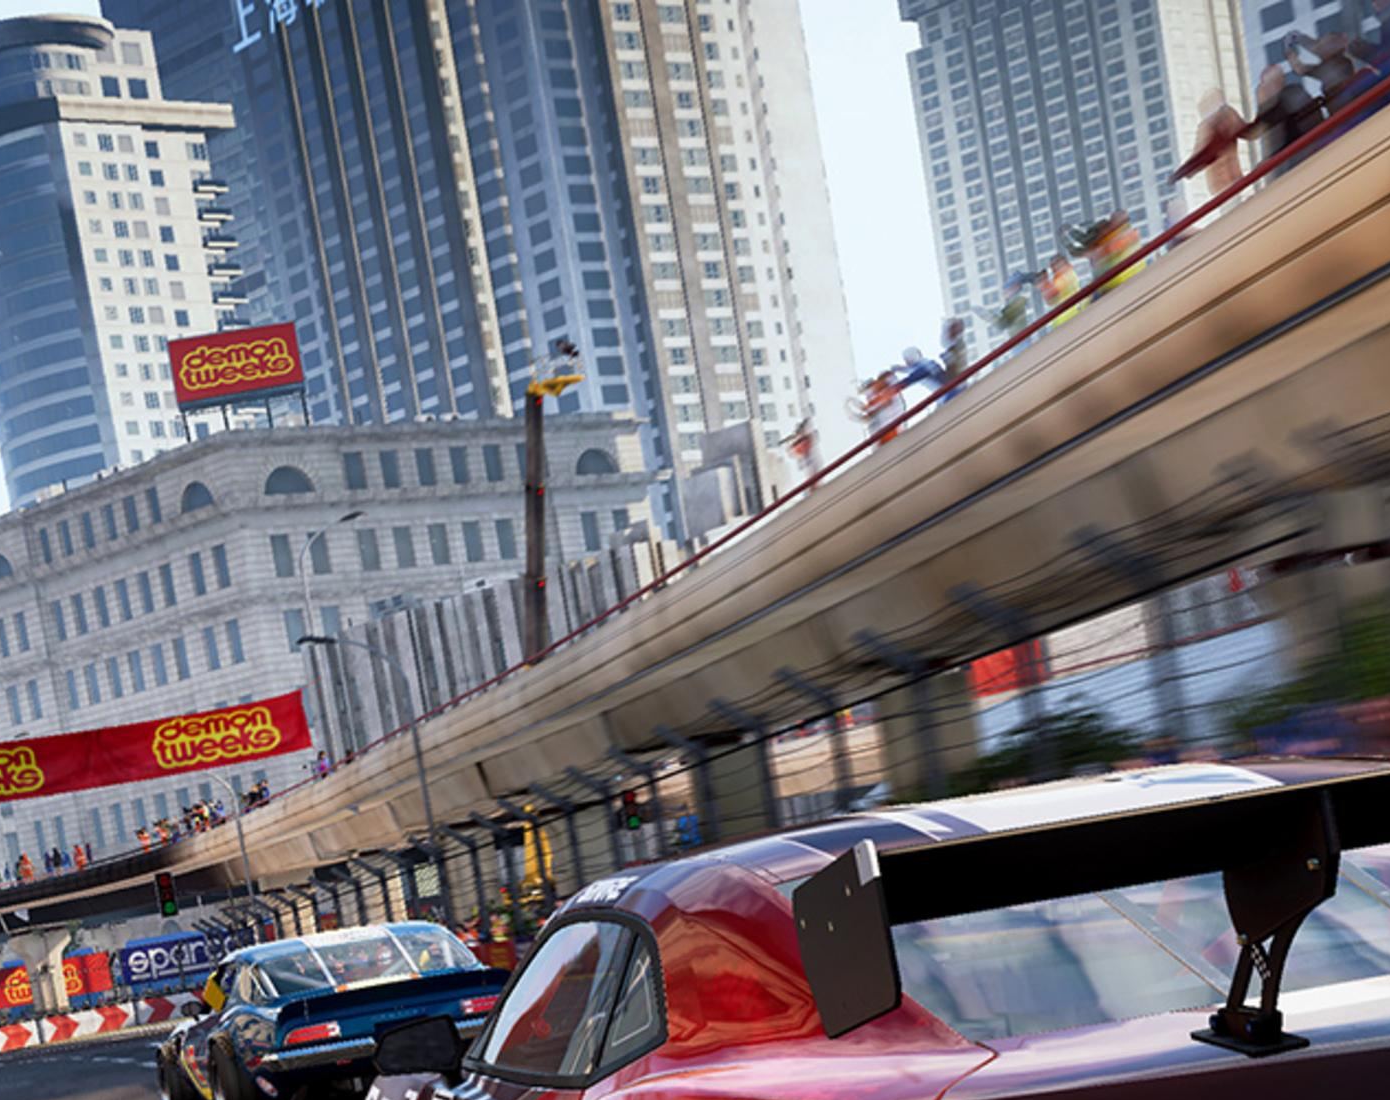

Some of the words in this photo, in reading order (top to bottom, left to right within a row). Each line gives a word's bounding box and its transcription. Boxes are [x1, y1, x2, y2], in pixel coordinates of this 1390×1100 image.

[233, 0, 326, 53] 上海
[183, 355, 292, 387] tweeks
[184, 341, 285, 369] demon
[156, 709, 269, 740] demon
[155, 725, 277, 765] tweeks
